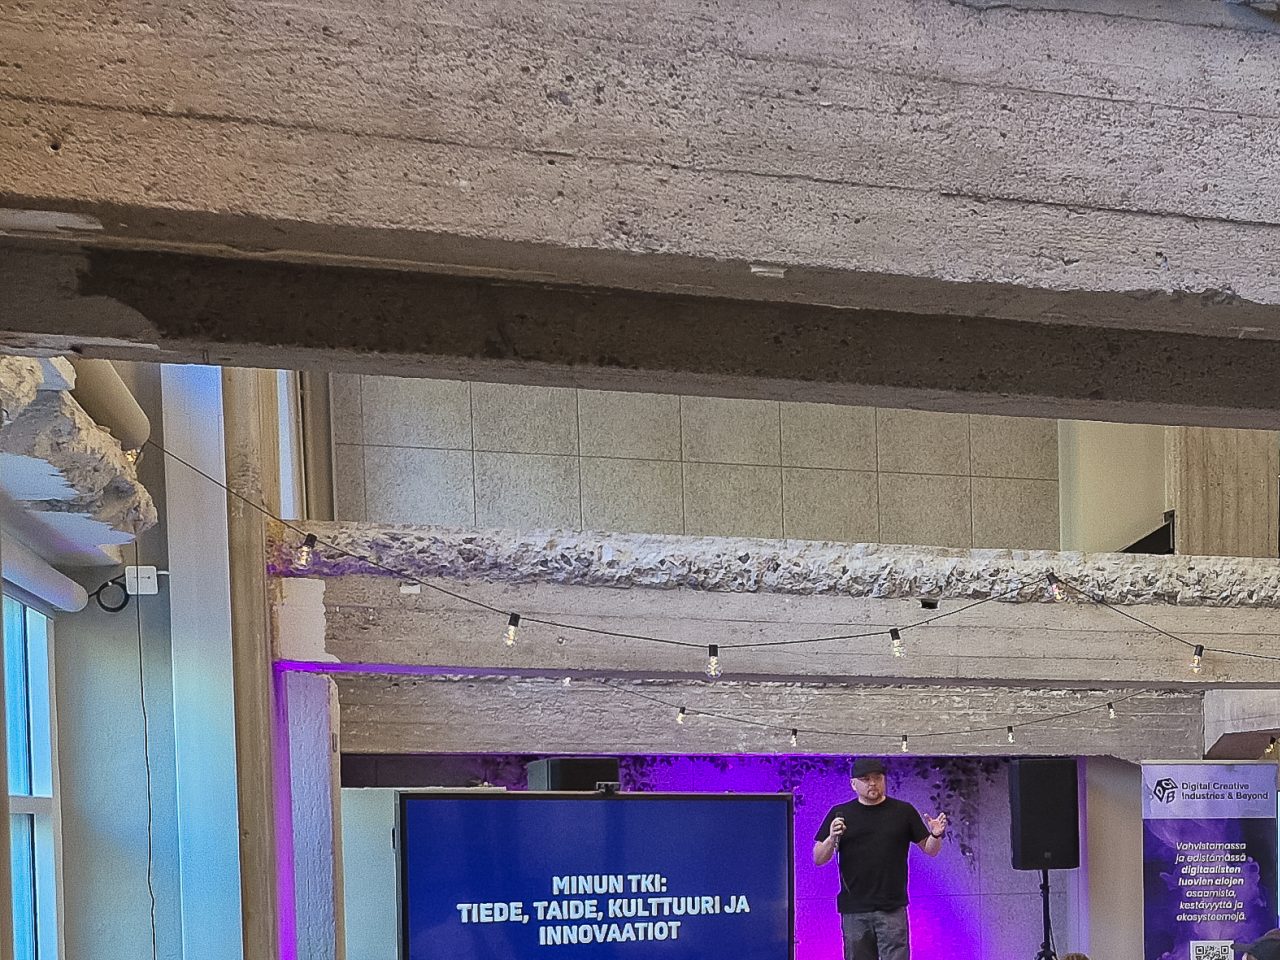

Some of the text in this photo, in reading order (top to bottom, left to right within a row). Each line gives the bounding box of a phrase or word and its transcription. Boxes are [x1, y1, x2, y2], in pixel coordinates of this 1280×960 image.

[1181, 782, 1249, 791] Digital Creative
[1181, 791, 1269, 801] Industries & Beyond
[1176, 842, 1247, 850] Vahvistamassa
[1174, 853, 1247, 864] ja edistämässä
[1181, 865, 1241, 876] digitaalisten
[552, 873, 667, 895] MINUN TKI:
[1178, 877, 1244, 887] luovien alojen
[1185, 889, 1237, 898] osaamista,
[456, 895, 750, 924] TIEDE, TAIDE, KULTTUURI JA
[1233, 900, 1243, 910] ja
[539, 921, 681, 945] INNOVAATIOT
